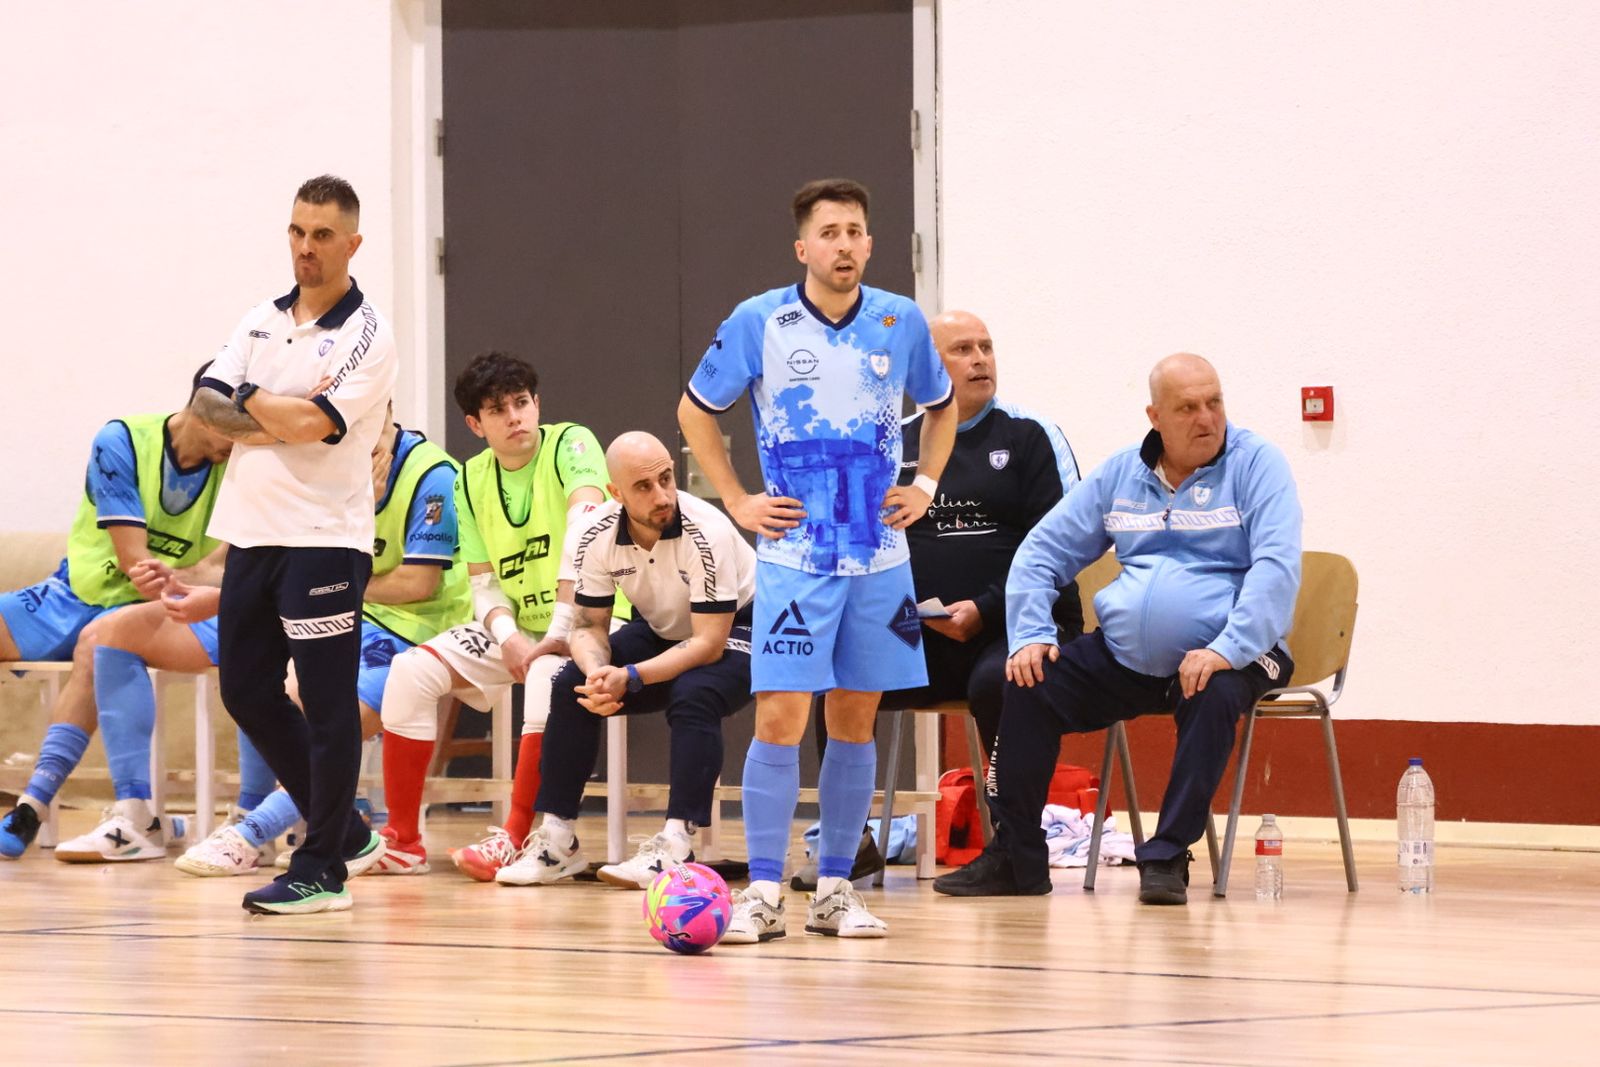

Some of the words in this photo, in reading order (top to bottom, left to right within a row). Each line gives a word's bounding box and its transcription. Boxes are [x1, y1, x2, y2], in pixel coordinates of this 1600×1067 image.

[786, 358, 820, 366] NISSAN
[17, 591, 36, 613] TIO
[762, 640, 814, 656] ACTIO
